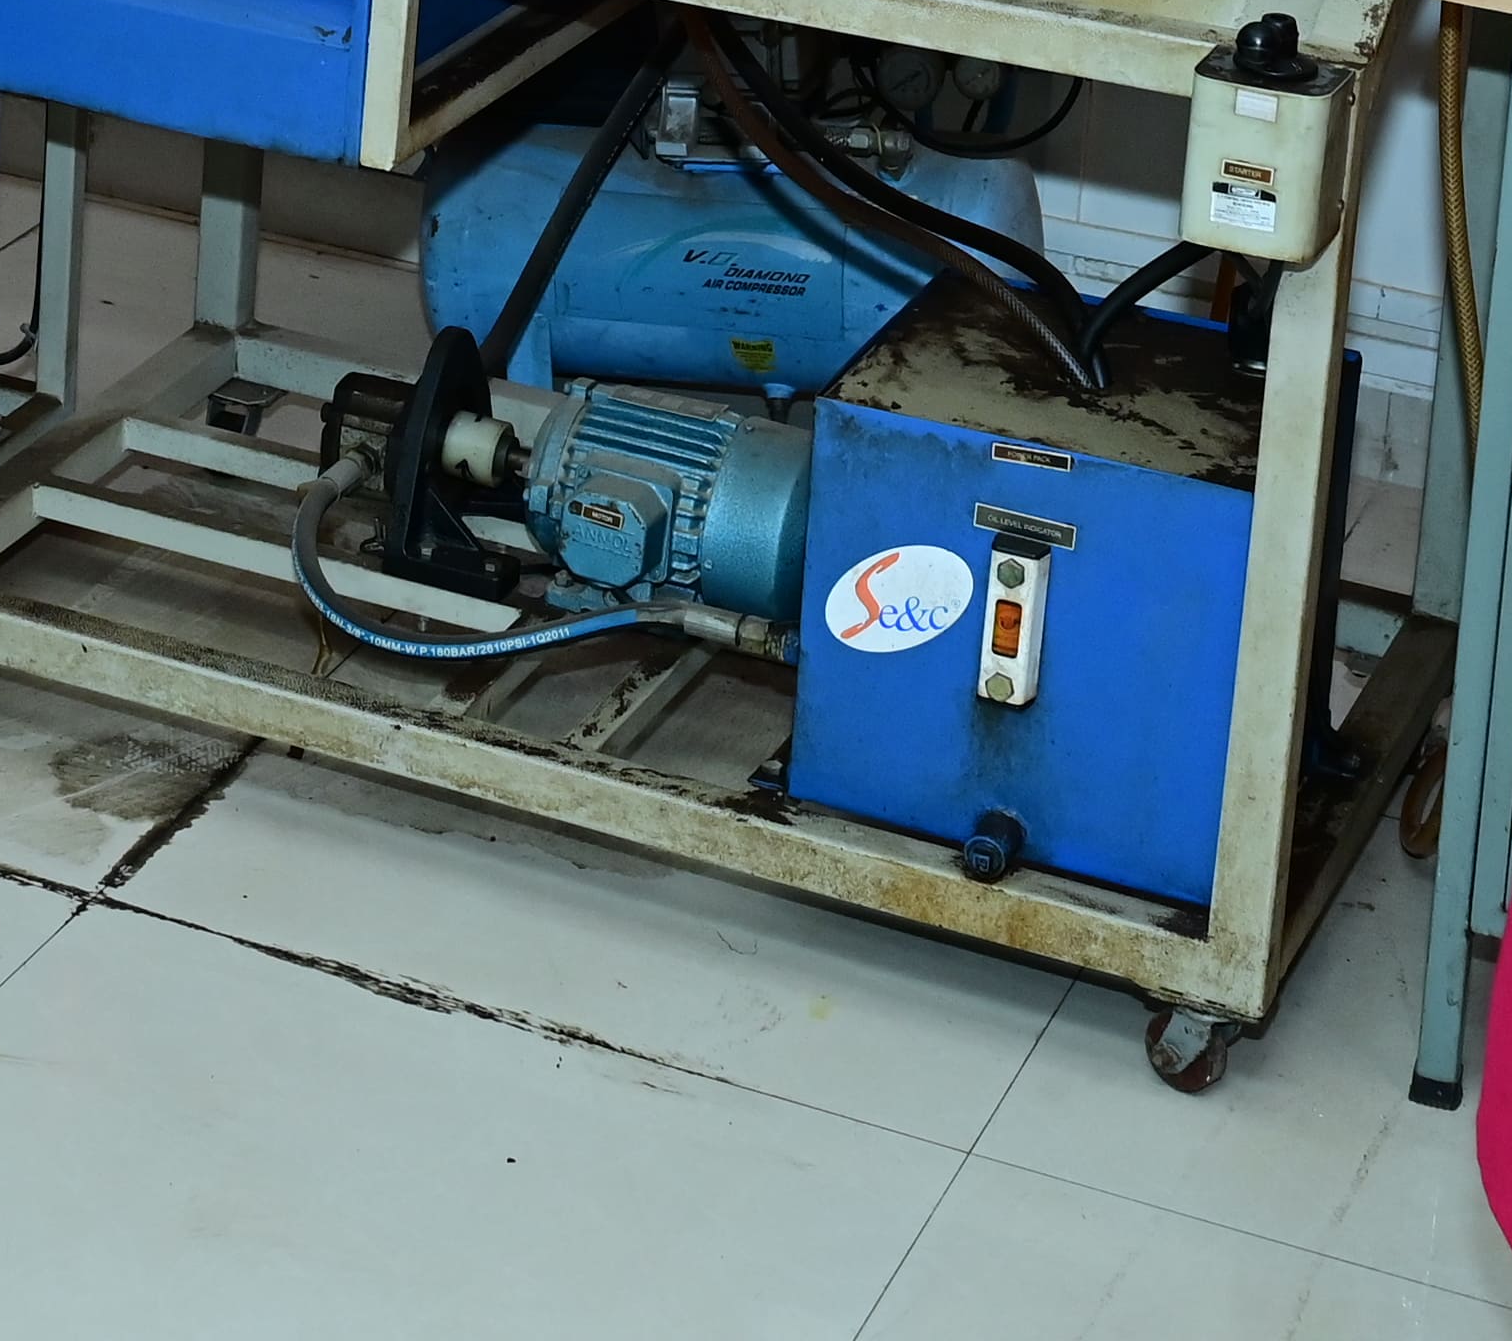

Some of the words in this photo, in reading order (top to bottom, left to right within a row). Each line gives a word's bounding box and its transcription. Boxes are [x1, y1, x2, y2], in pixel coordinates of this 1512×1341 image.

[1228, 165, 1262, 179] STARTER
[723, 267, 810, 285] DIAMOND
[702, 279, 722, 289] AIR
[724, 280, 806, 297] COMPRESSOR
[591, 510, 614, 525] MOTOR
[987, 513, 1000, 525] OIL
[1000, 517, 1024, 531] LEVEL
[1023, 523, 1062, 539] INDICATOR
